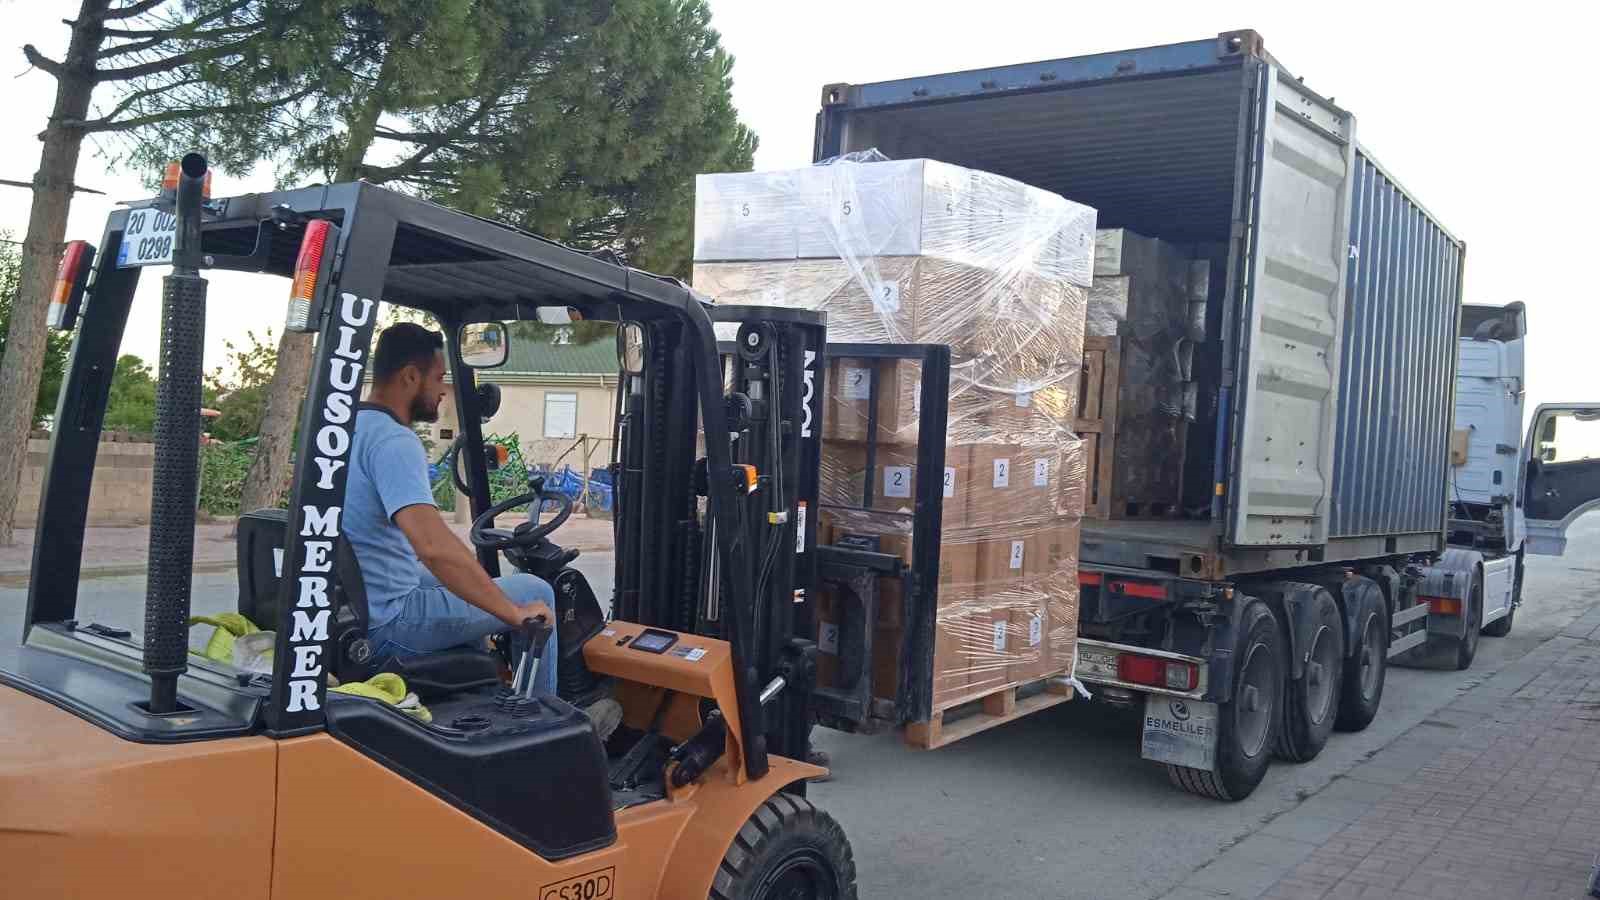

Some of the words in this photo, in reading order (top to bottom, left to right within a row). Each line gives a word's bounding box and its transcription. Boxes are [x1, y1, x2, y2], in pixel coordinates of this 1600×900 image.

[741, 203, 751, 217] 5
[841, 200, 852, 216] 5
[127, 211, 146, 235] 20
[137, 235, 172, 260] 0298
[315, 293, 373, 490] ULUSOY
[999, 463, 1005, 477] 2
[893, 471, 902, 487] 2
[943, 472, 951, 487] 2
[1015, 544, 1021, 559] 2
[287, 506, 341, 712] MERMER
